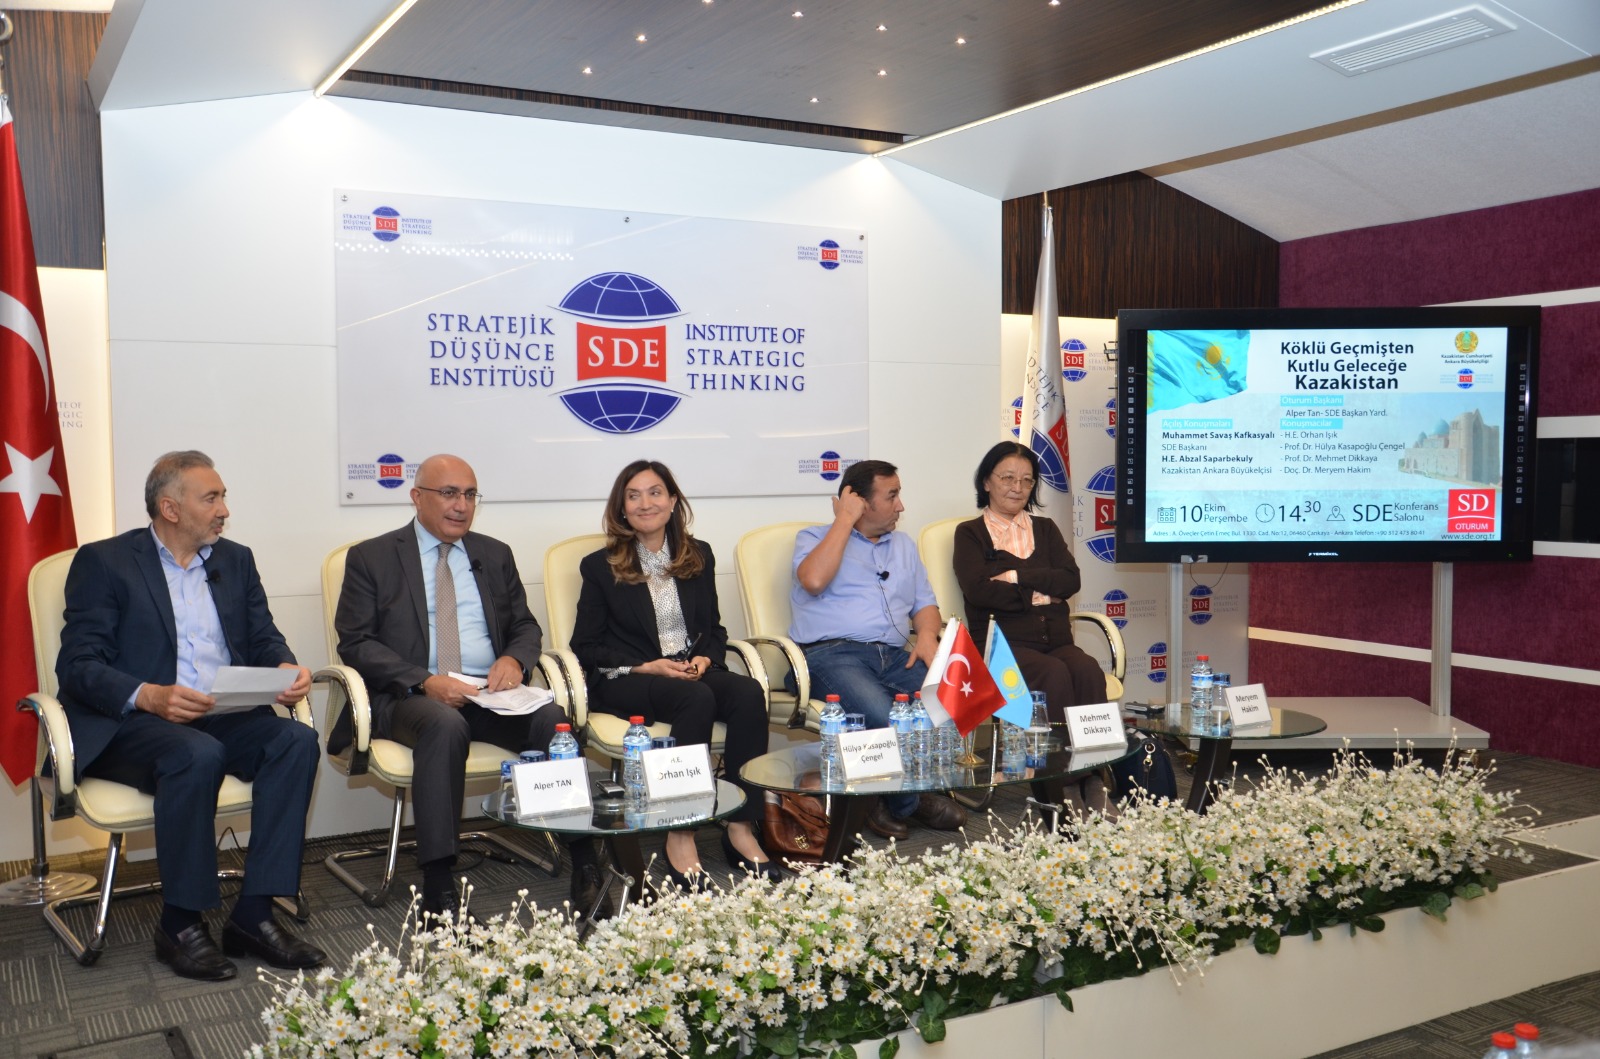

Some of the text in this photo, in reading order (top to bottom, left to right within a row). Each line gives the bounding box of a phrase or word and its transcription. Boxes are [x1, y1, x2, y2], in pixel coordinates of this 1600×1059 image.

[378, 220, 396, 228] SDE
[428, 312, 555, 336] STRATEJİK
[686, 324, 806, 344] INSTITUTE OF
[430, 336, 555, 363] DÜŞÜNCE
[588, 336, 660, 368] SDE
[1281, 341, 1414, 357] Köklü Geçmişten
[686, 349, 805, 368] STRATEGIC
[1065, 355, 1083, 365] SDE
[1288, 359, 1407, 375] Kutlu Geleceğe
[430, 364, 555, 388] ENSTİTÜSÜ
[688, 373, 805, 392] THINKING
[1295, 374, 1398, 389] Kazakistan
[1282, 396, 1312, 404] Oturum
[1286, 409, 1306, 418] Alper
[1342, 409, 1368, 418] Başkan
[1210, 432, 1232, 440] Savaş
[1234, 431, 1274, 440] Kafkasyalı
[1178, 443, 1207, 452] Başkanı
[1315, 443, 1336, 451] Hülya
[1338, 443, 1377, 451] Kasapoğlu
[1379, 443, 1405, 451] Çengel
[1203, 455, 1253, 463] Saparbekuly
[1348, 455, 1378, 463] Dikkaya
[1231, 467, 1272, 475] Büyükelçisi
[1315, 467, 1345, 475] Meryem
[1458, 494, 1489, 512] SD
[1180, 504, 1226, 522] 10 Ekim
[1353, 502, 1439, 522] SDE Konferans
[1204, 514, 1248, 524] Perşembe
[1394, 513, 1424, 522] Salonu
[1441, 533, 1495, 541] www.sde.org.tr
[1193, 600, 1209, 609] SDE
[1108, 607, 1124, 615] SDE
[1236, 694, 1259, 703] Meryem
[1241, 705, 1259, 713] Hakim
[1080, 713, 1111, 723] Mehmet
[1084, 726, 1112, 735] Dikkaya
[843, 744, 862, 753] Hülya
[861, 753, 884, 763] Çengel
[686, 767, 701, 778] Işık
[534, 779, 572, 791] Alper TAN
